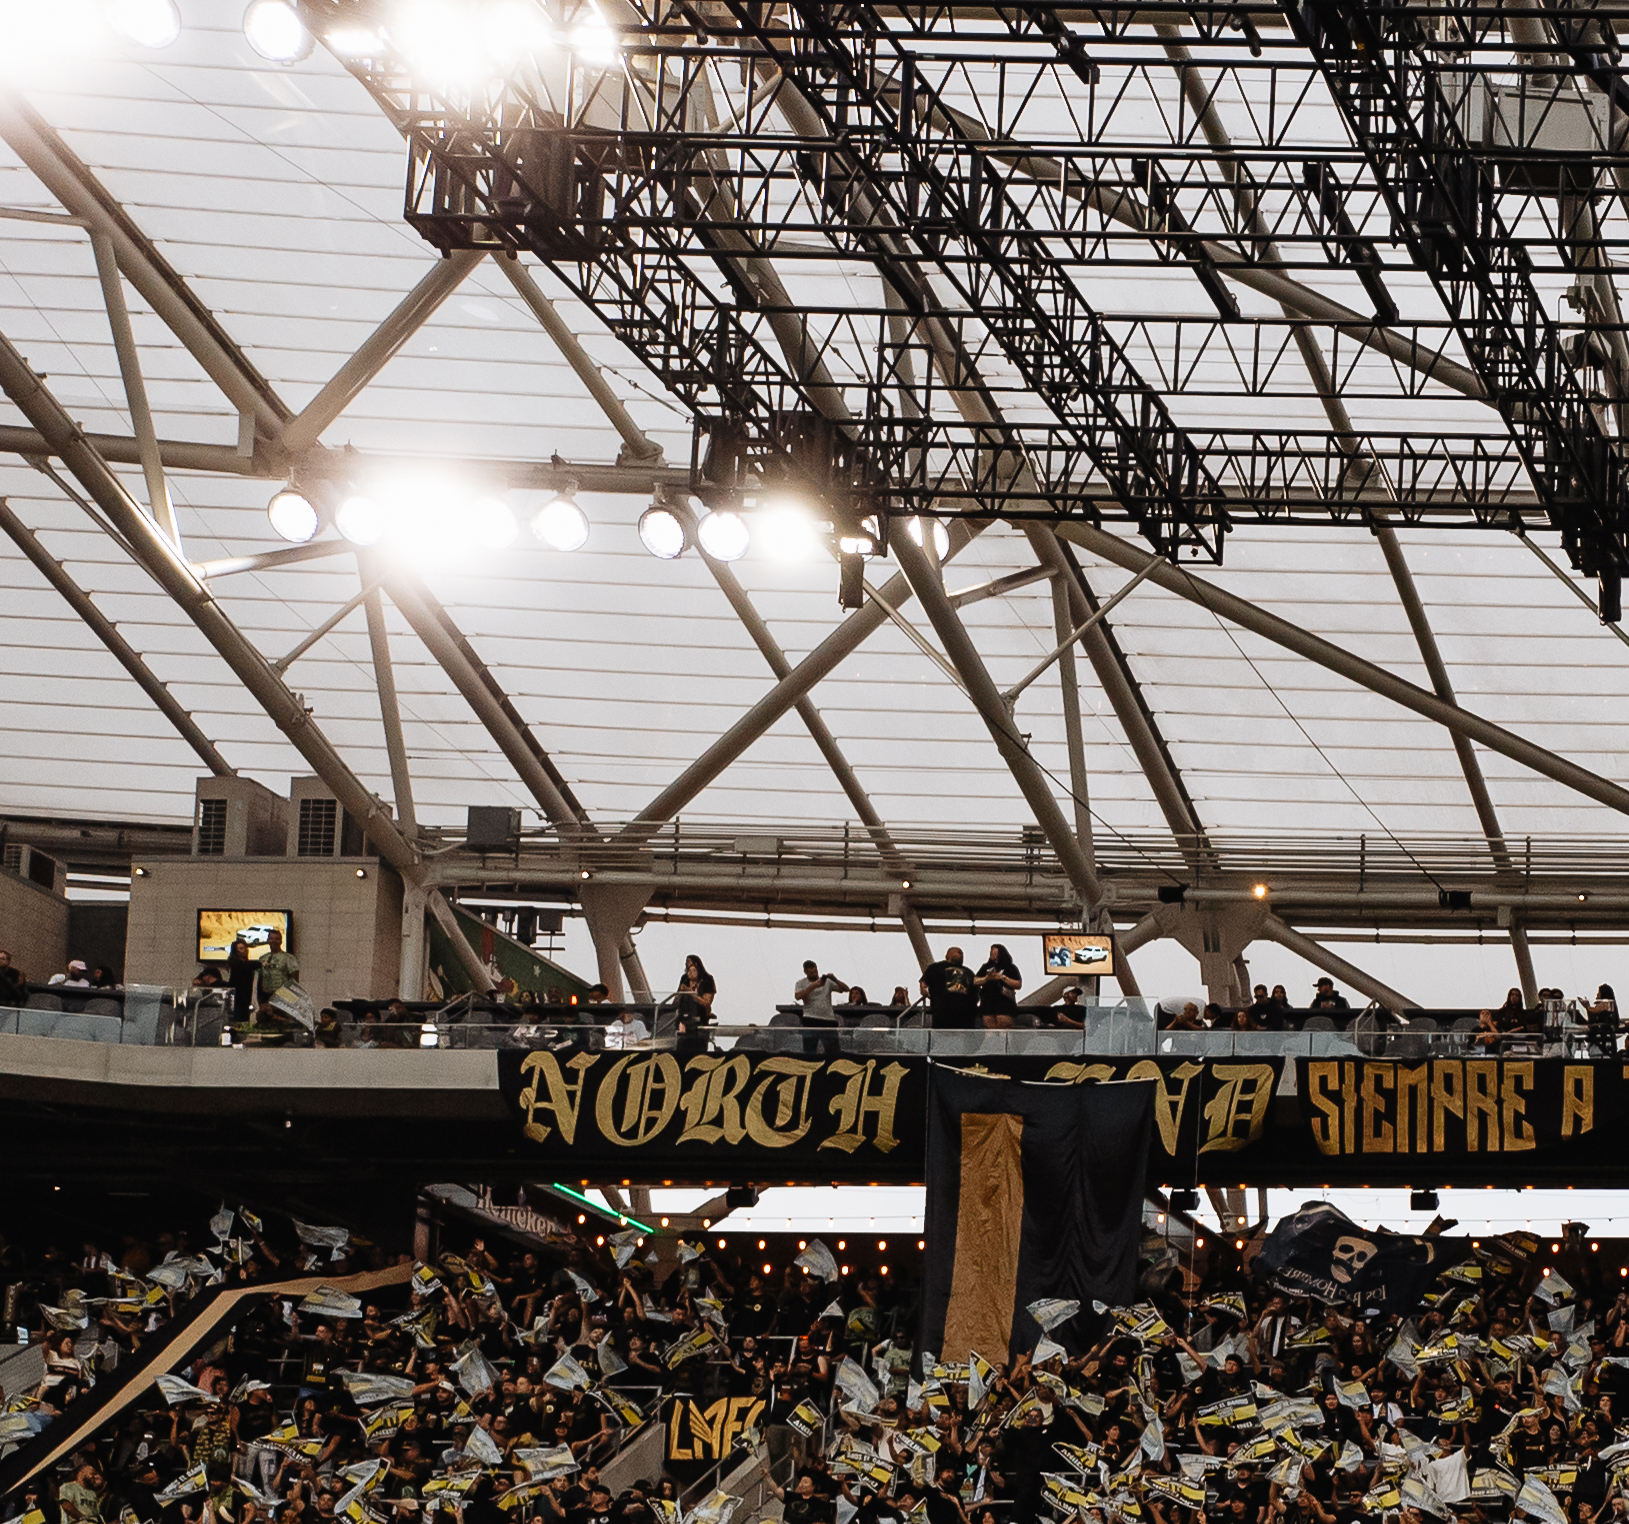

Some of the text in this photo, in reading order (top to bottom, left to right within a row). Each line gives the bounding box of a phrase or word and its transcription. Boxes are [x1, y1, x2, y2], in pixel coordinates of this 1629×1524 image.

[517, 1049, 911, 1155] NORTH
[1309, 1060, 1537, 1156] SIEMPRE
[1561, 1065, 1595, 1139] A
